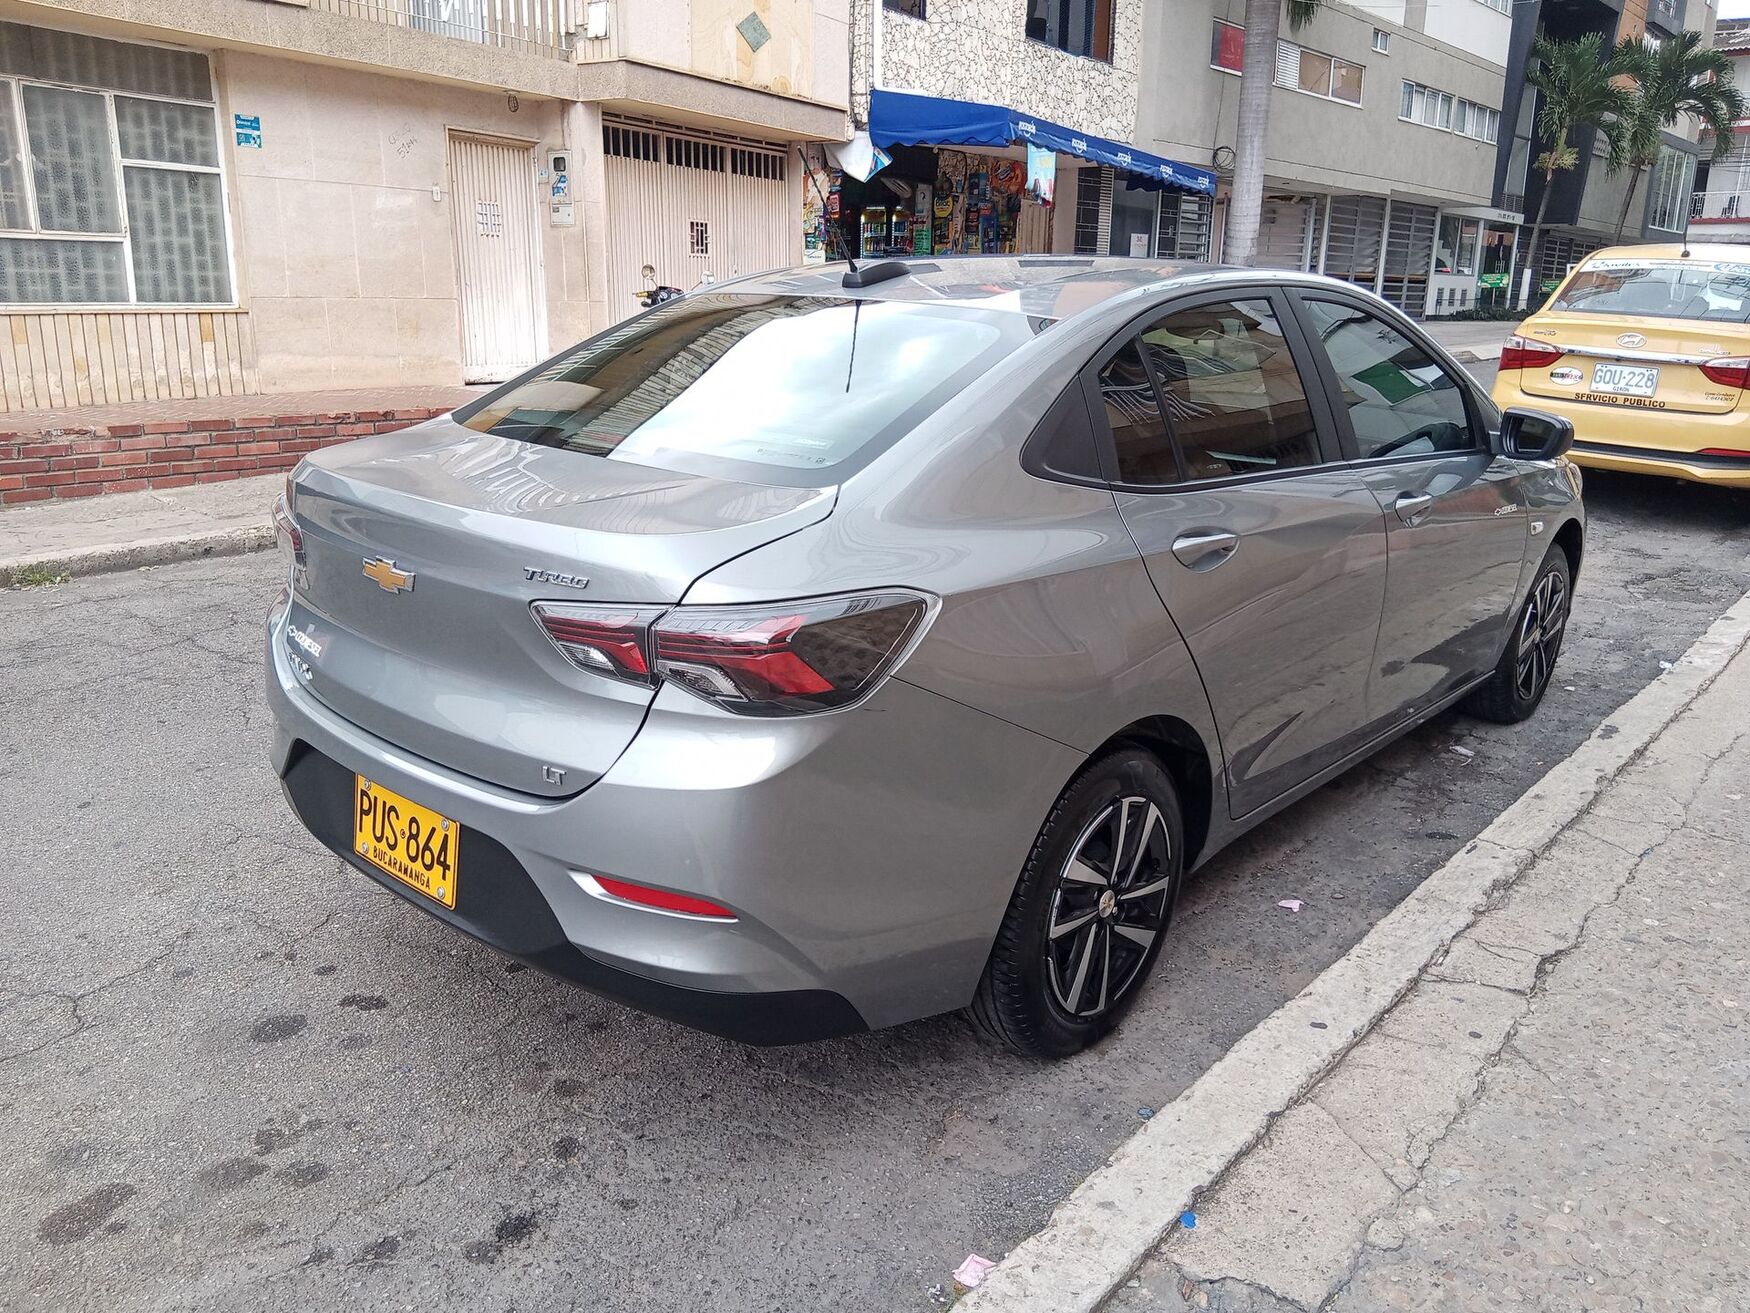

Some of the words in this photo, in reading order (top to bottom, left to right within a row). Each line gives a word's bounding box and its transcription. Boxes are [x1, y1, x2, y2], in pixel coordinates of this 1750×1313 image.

[1574, 392, 1618, 404] SERVICIO
[1622, 397, 1666, 408] PUBLICO
[542, 765, 567, 786] LT
[372, 844, 432, 890] BUCARAMANGA
